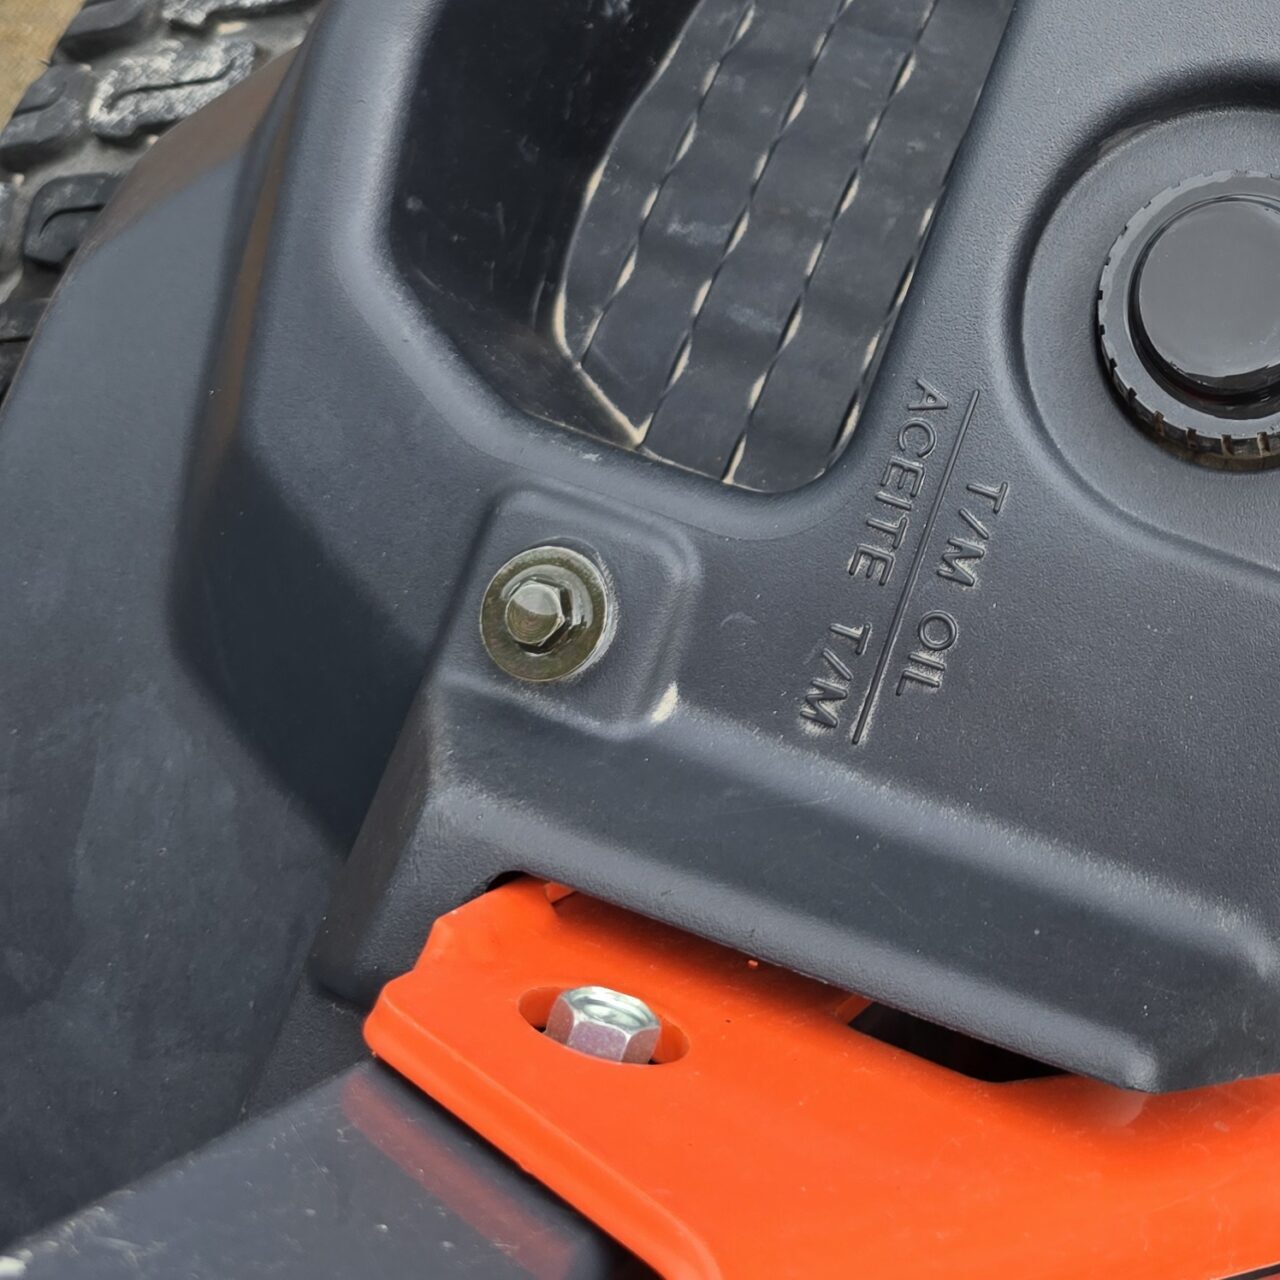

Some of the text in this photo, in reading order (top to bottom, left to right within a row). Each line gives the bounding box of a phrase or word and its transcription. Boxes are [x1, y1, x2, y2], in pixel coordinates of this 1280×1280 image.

[800, 377, 949, 729] ACEITE T/M
[895, 480, 1009, 697] T/M OIL
